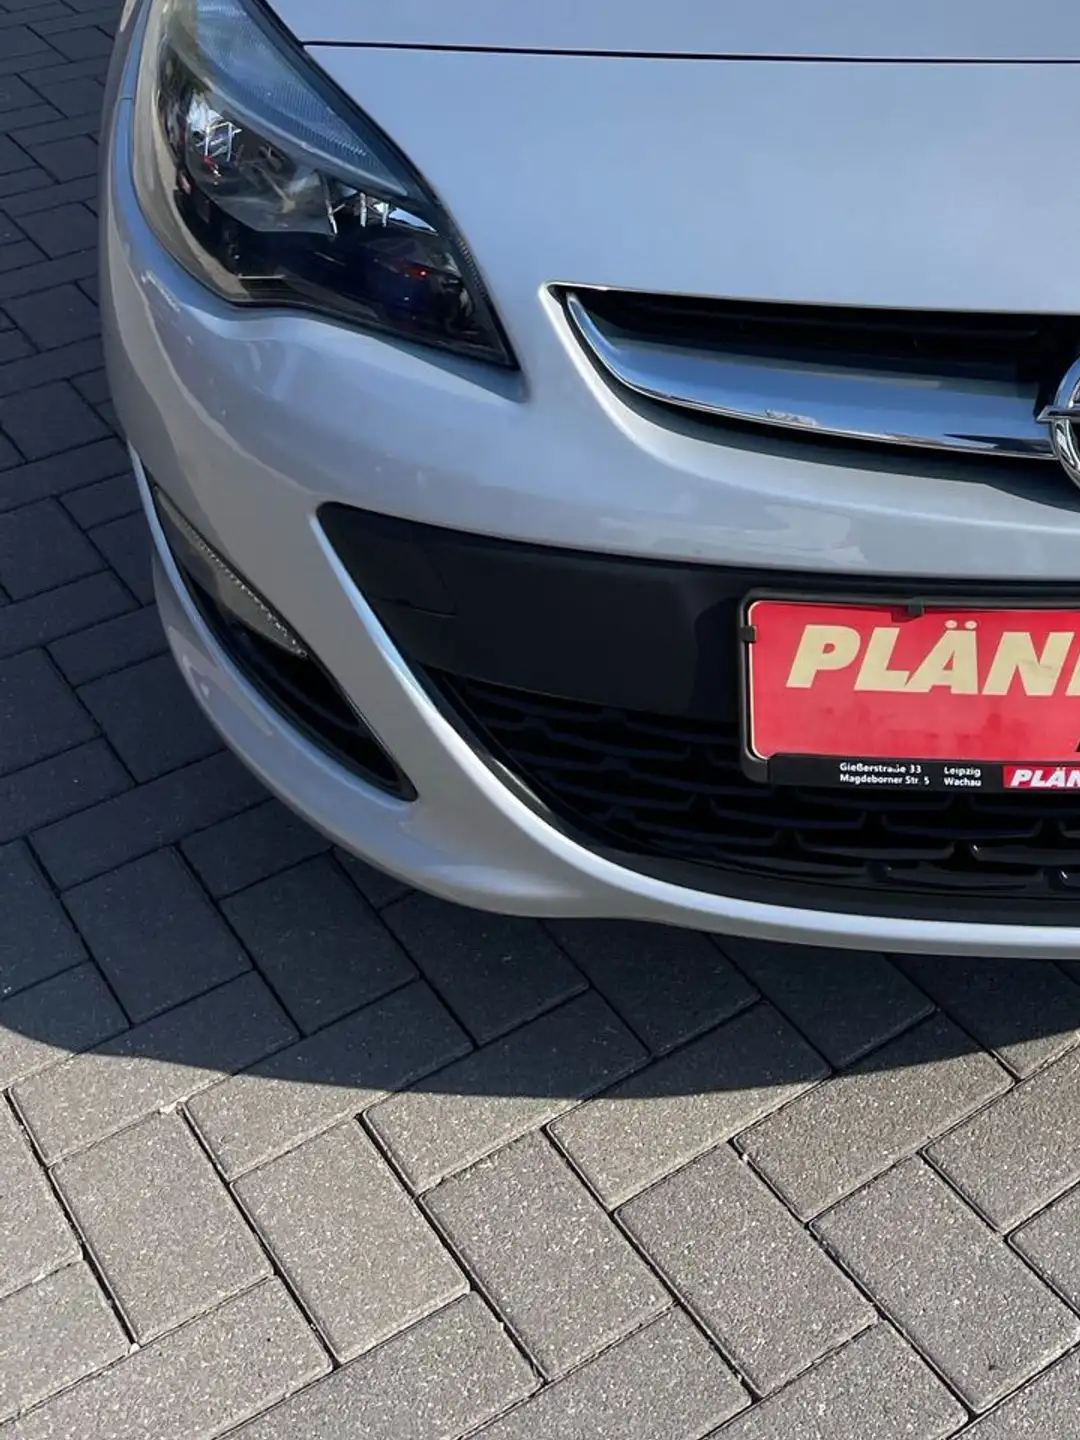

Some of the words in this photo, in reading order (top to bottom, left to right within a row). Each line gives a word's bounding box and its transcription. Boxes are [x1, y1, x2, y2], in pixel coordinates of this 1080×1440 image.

[909, 764, 922, 774] 33
[943, 766, 981, 778] Leipzig
[839, 774, 903, 785] Magdeborner
[923, 776, 930, 785] 5
[943, 777, 982, 787] Wachau
